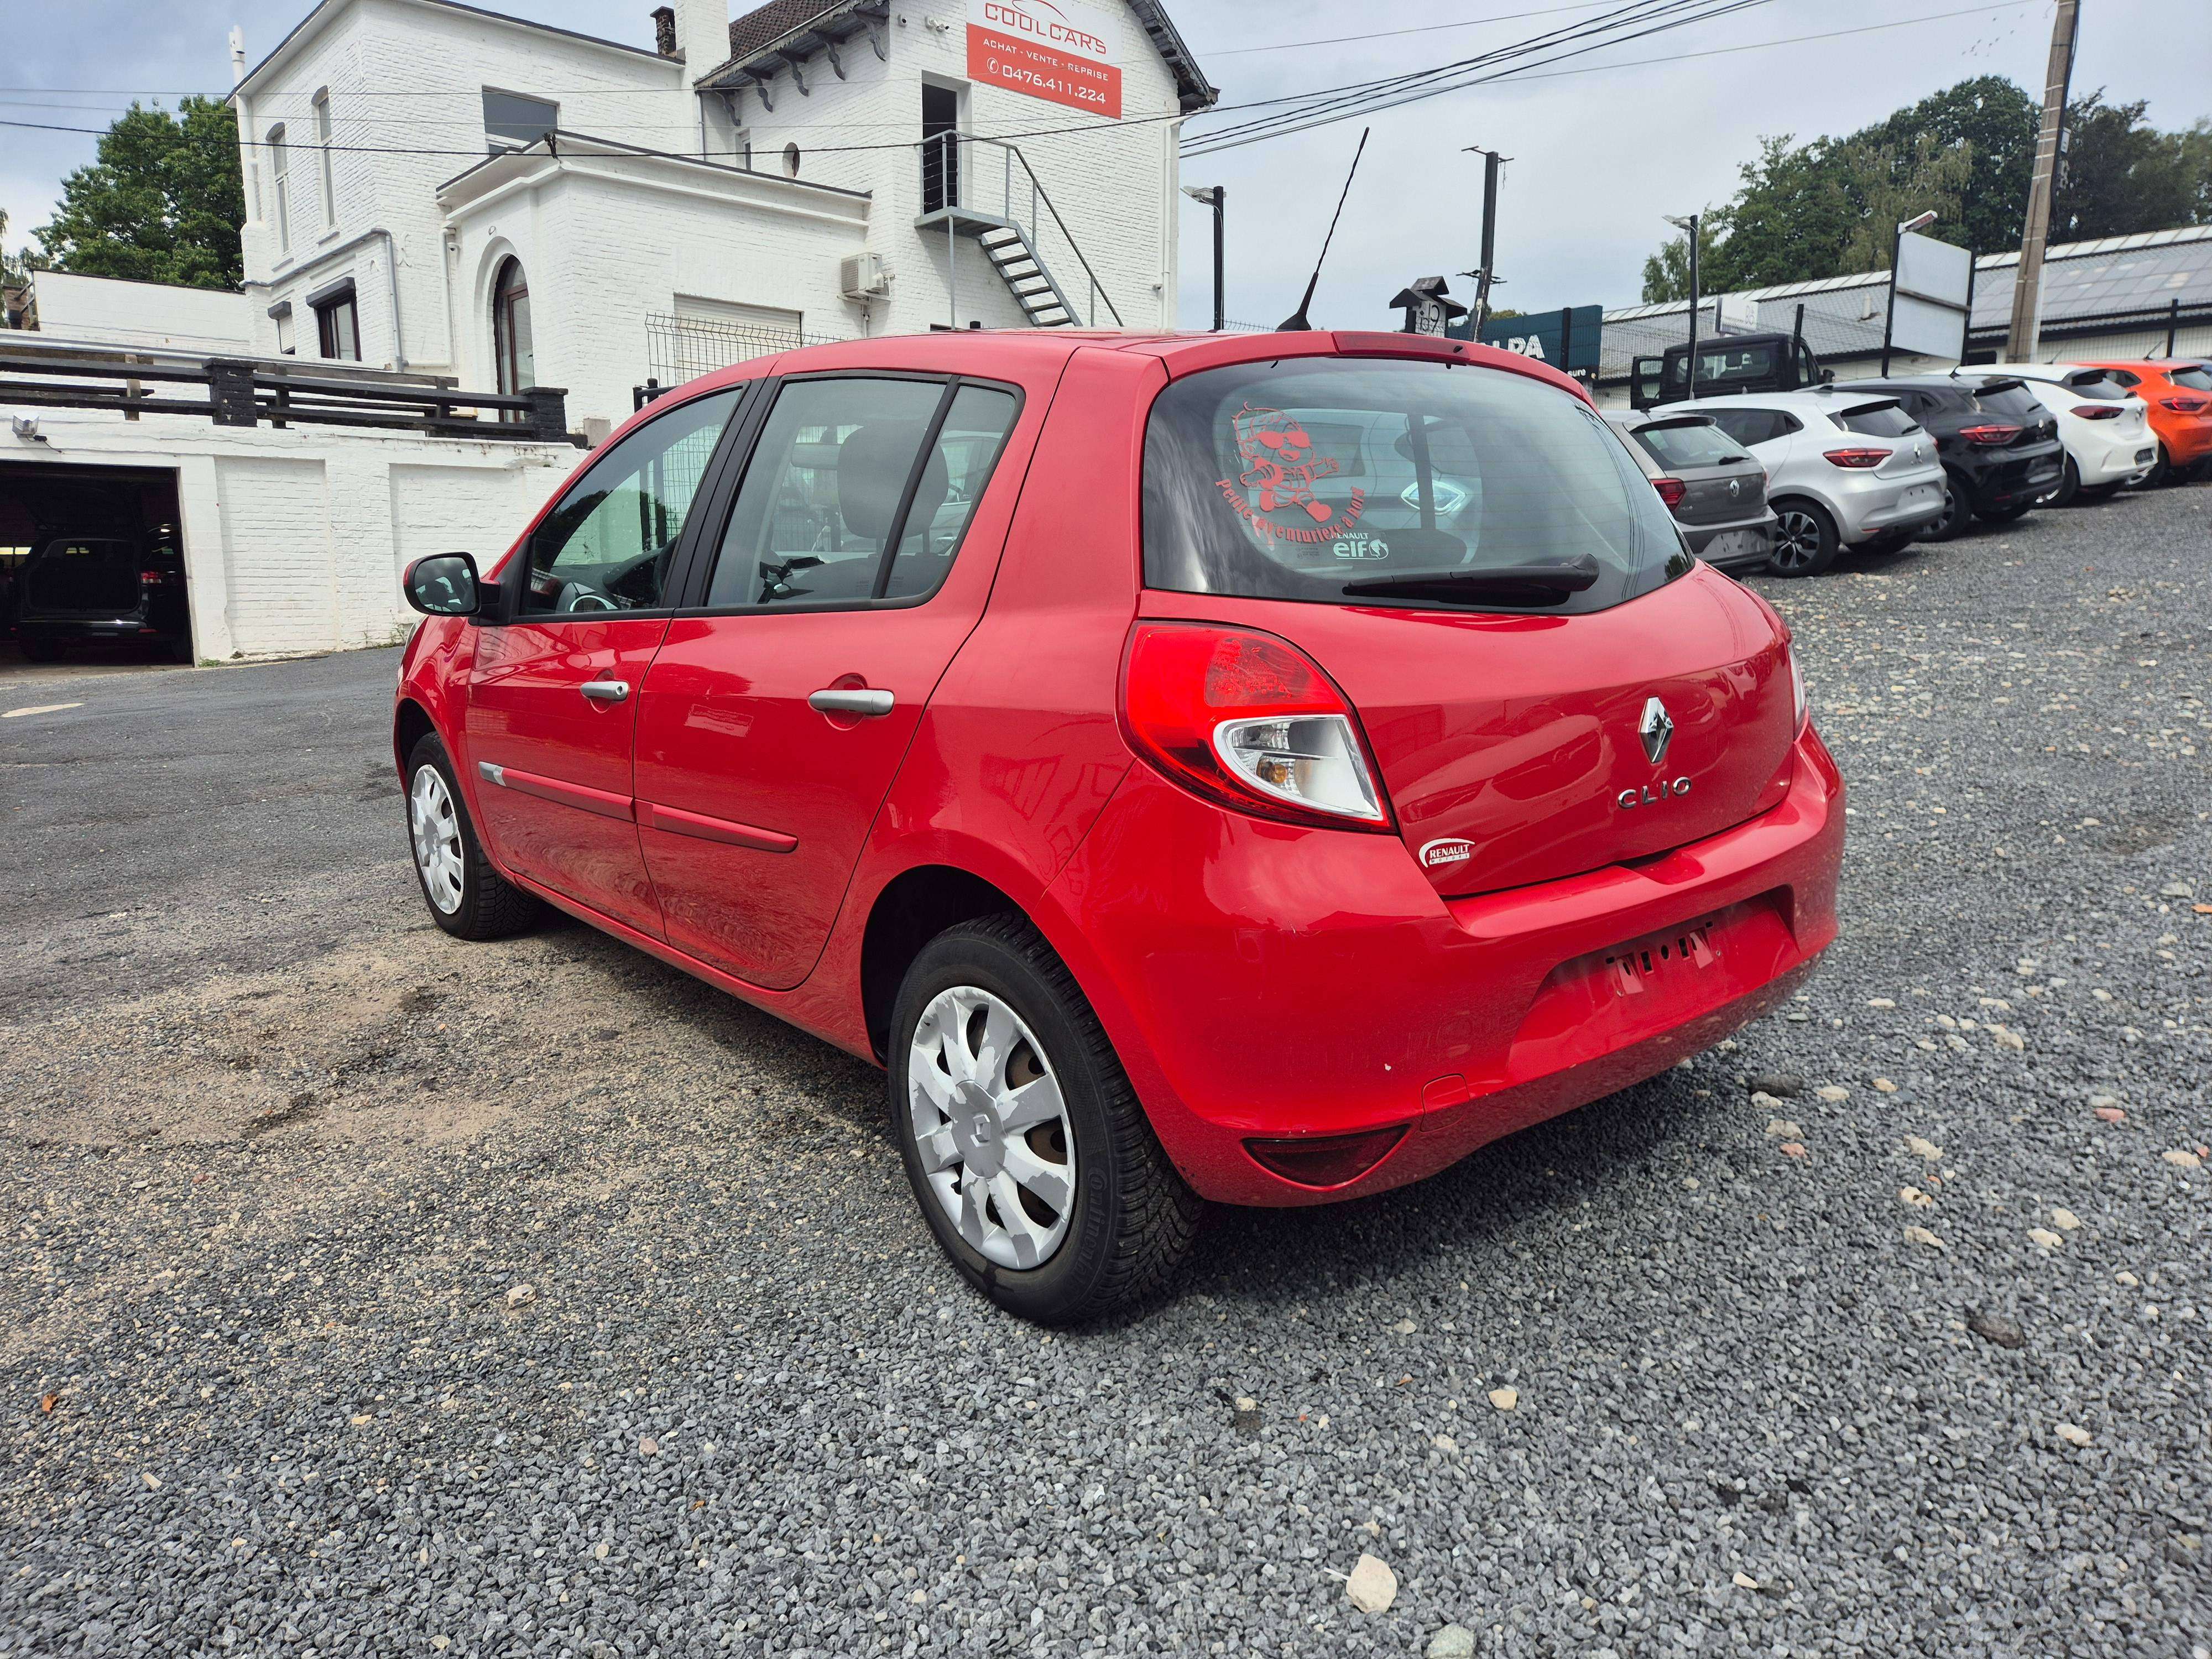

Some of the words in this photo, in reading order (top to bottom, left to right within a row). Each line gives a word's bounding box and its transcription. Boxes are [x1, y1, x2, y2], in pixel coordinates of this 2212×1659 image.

[983, 39, 1017, 54] ACHAT
[1026, 50, 1058, 66] VENTE
[1067, 63, 1109, 81] REPRISE
[1002, 65, 1106, 104] 0476.411.224
[1333, 541, 1367, 557] elf
[1618, 776, 1692, 808] CLIO
[1429, 844, 1470, 858] RENAULT
